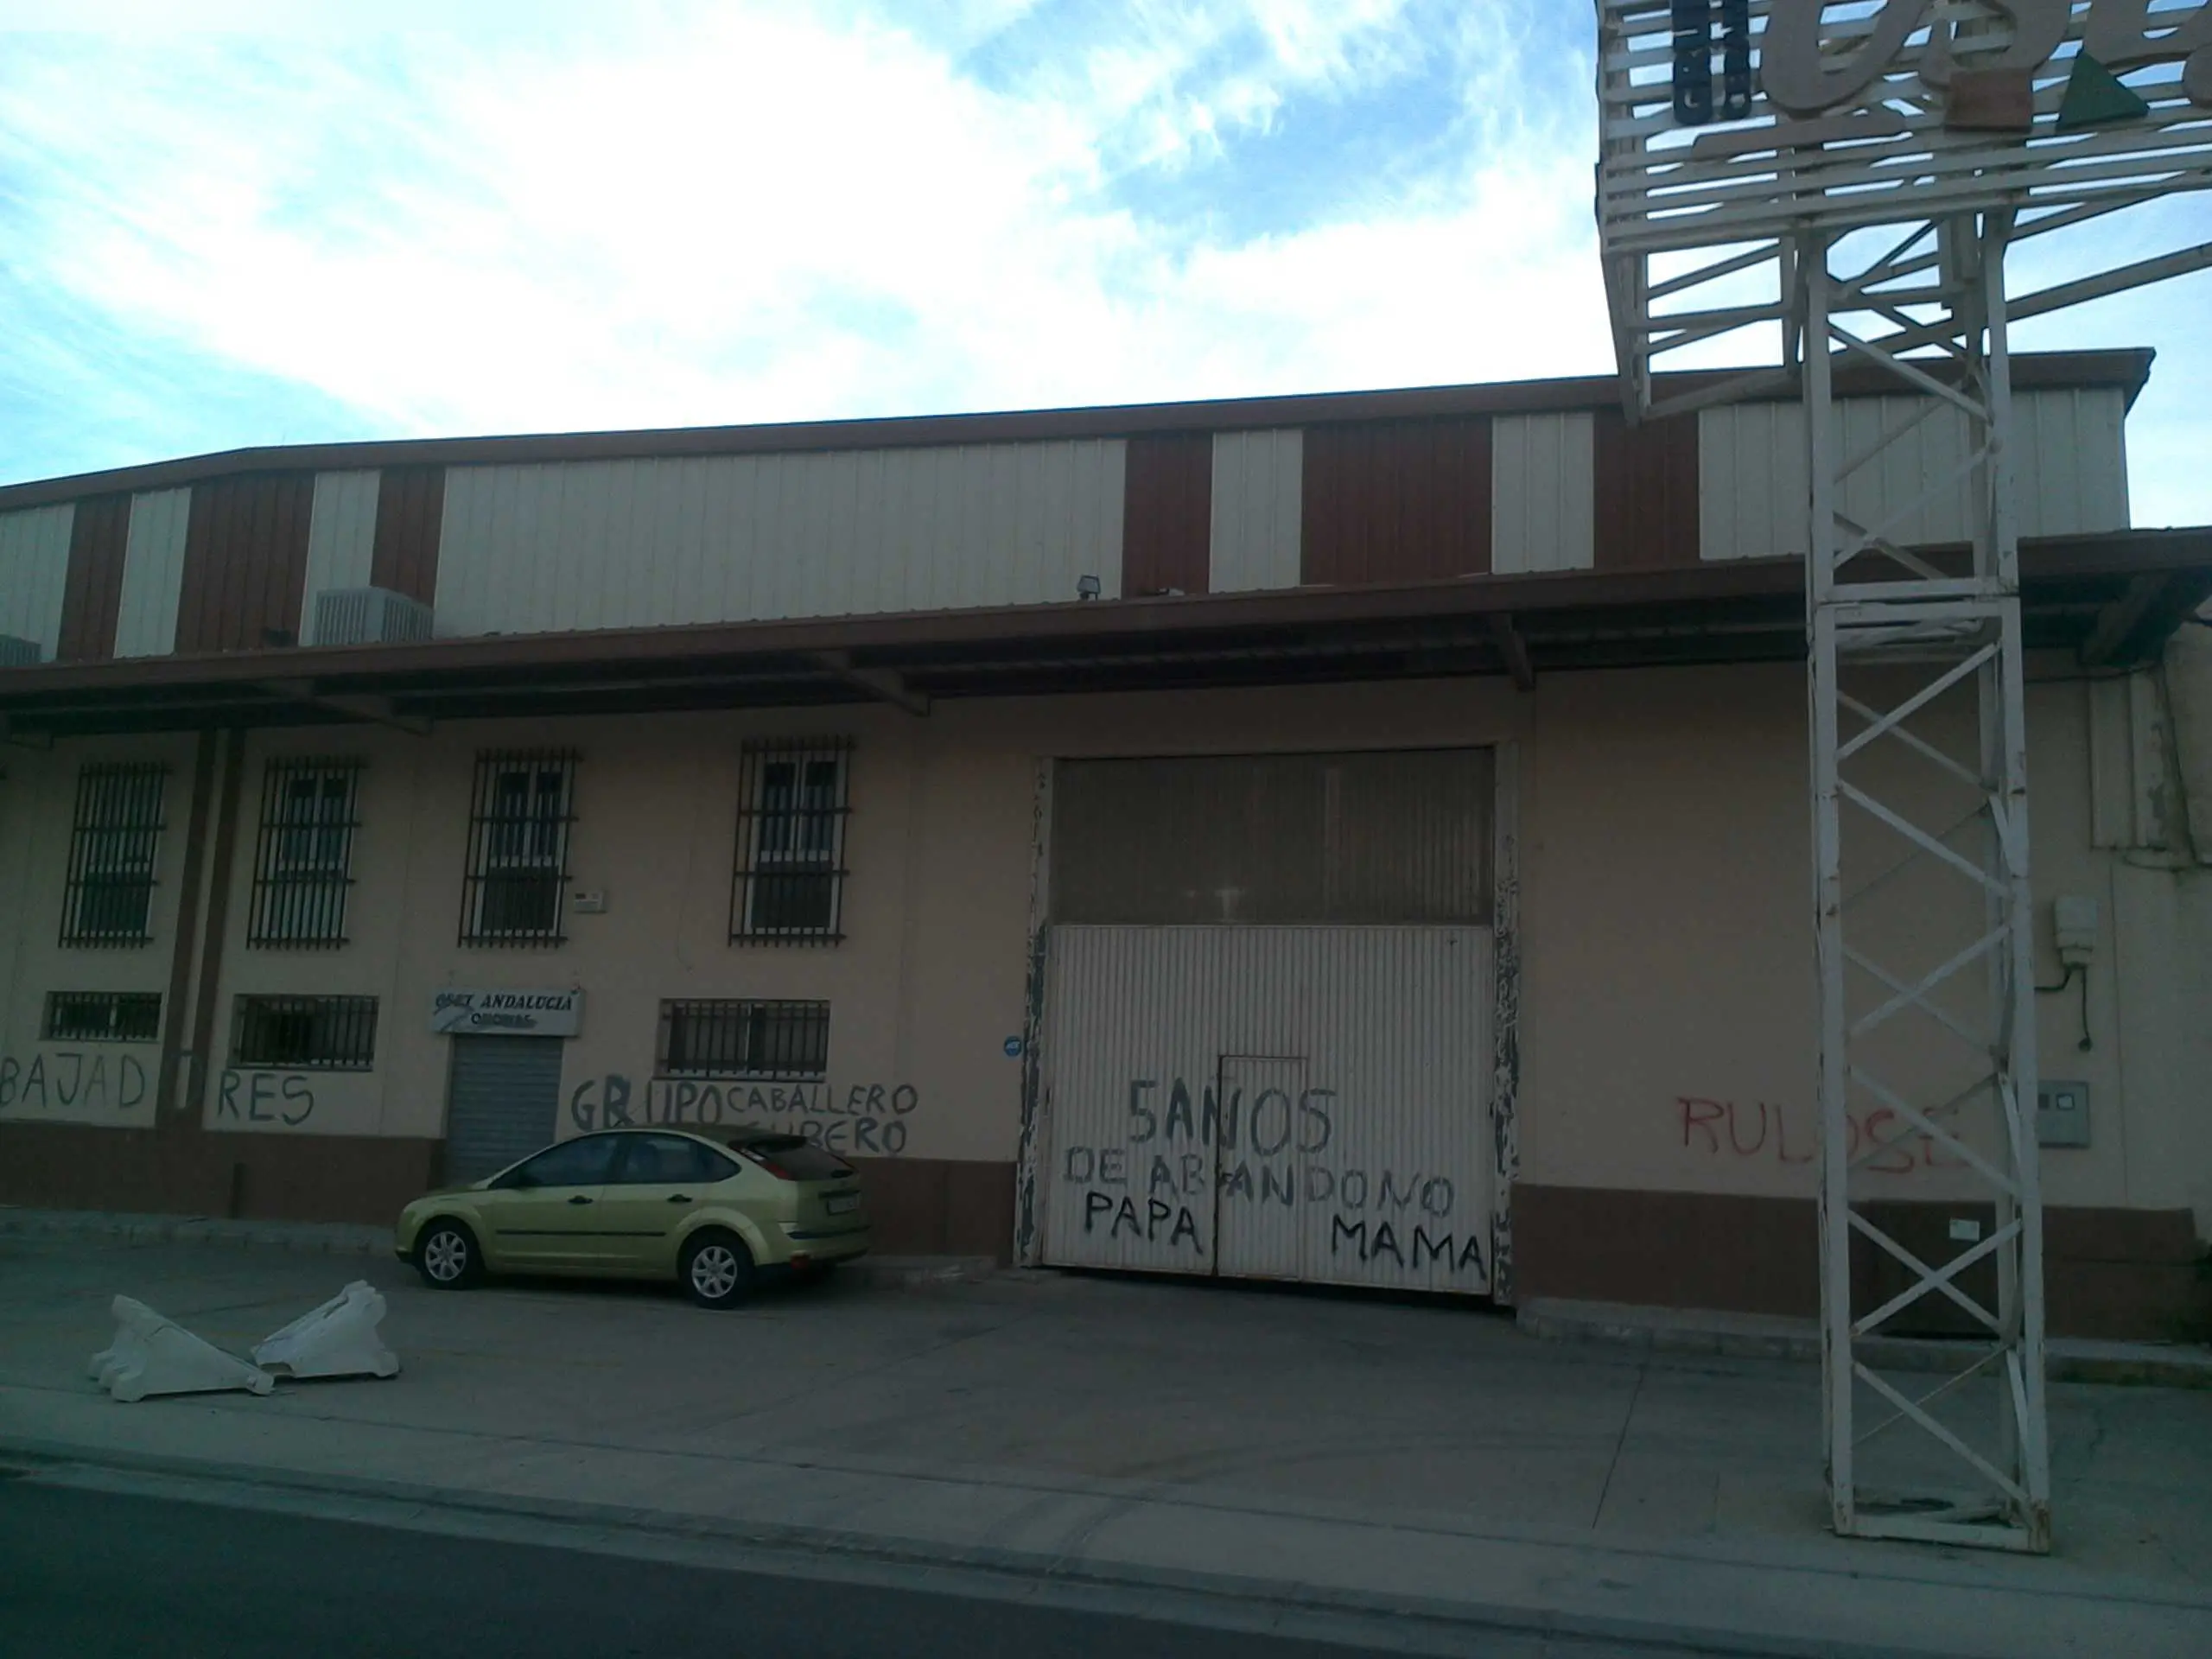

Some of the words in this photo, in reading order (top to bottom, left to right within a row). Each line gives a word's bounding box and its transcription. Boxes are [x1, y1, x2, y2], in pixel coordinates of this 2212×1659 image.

[480, 993, 572, 1011] ANDALUCIA
[571, 1075, 722, 1130] GRUPO
[726, 1084, 918, 1115] CABALLERO
[1063, 1147, 1127, 1184] DE
[1085, 1191, 1204, 1255] PAPA
[1332, 1213, 1487, 1281] MAMA
